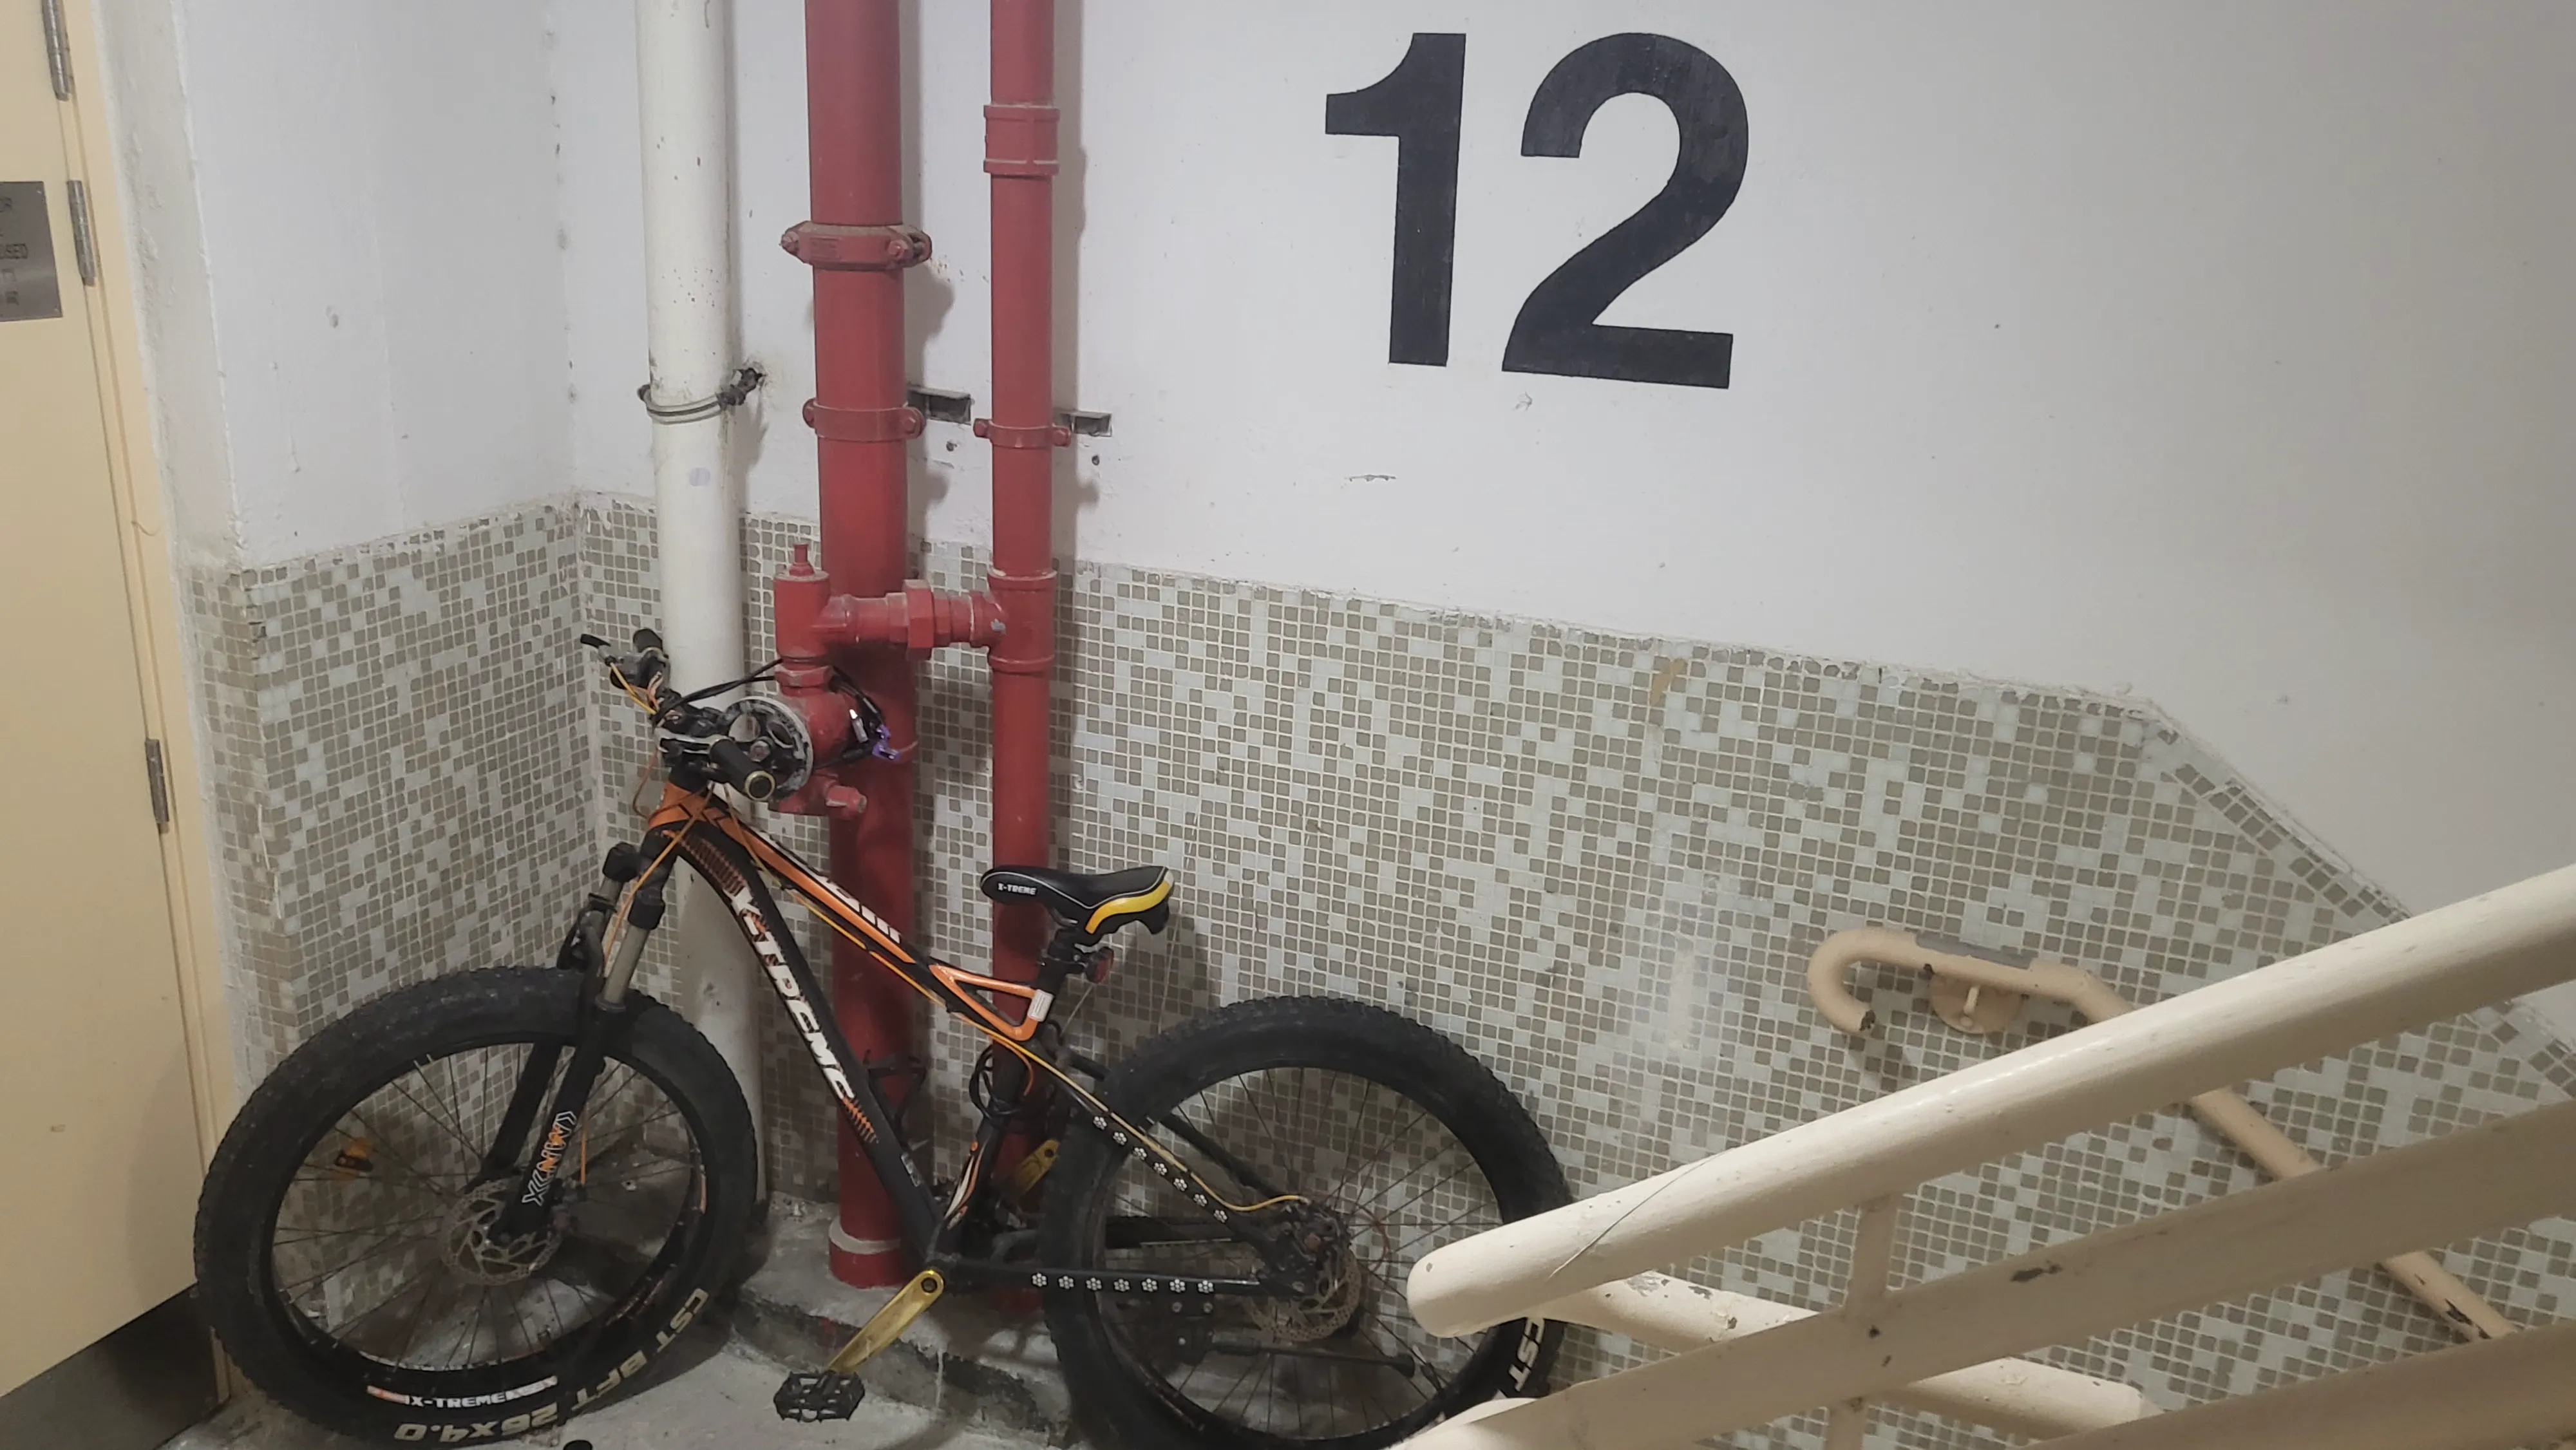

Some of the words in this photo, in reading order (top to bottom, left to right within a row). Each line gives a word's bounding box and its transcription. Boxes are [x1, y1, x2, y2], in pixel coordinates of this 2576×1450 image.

[1325, 32, 1748, 390] 12
[724, 887, 855, 1099] X-TREME
[656, 1288, 709, 1354] CST
[1508, 1317, 1546, 1393] CST
[411, 1391, 507, 1408] X-TREME
